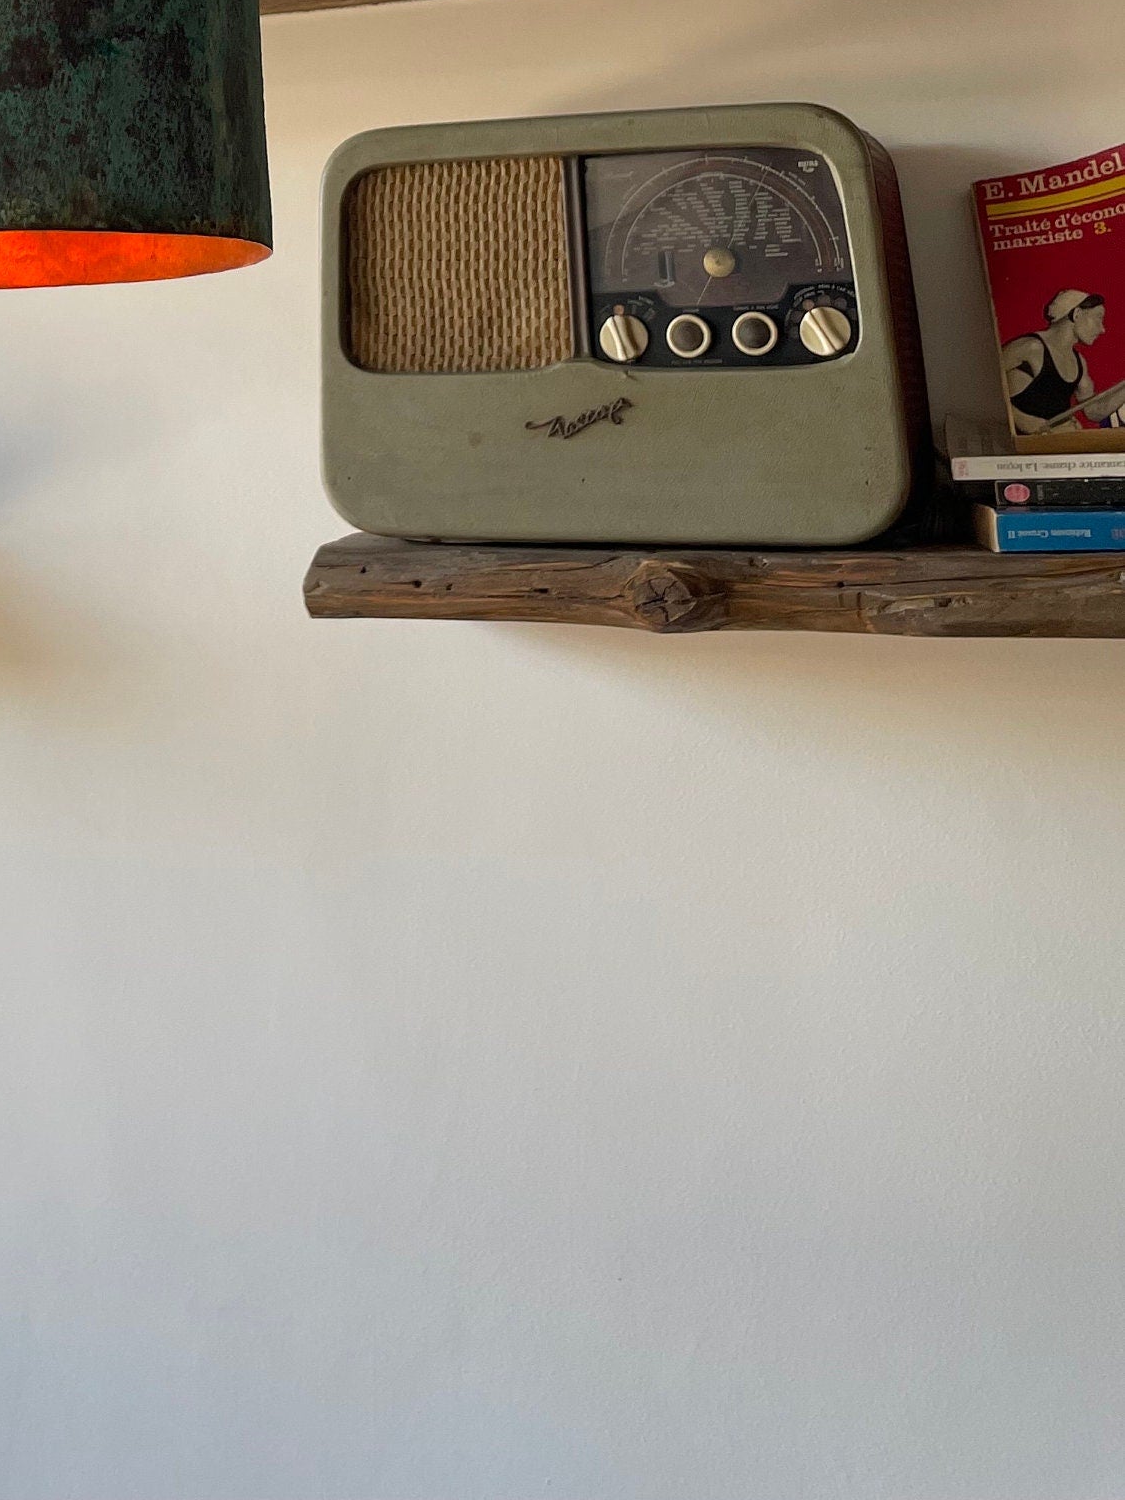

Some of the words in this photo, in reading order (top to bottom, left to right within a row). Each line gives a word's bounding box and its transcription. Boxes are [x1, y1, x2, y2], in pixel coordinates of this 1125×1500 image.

[981, 181, 1014, 200] E.
[1016, 151, 1125, 196] Mandel
[989, 217, 1051, 238] Traité
[993, 228, 1084, 251] marxiste
